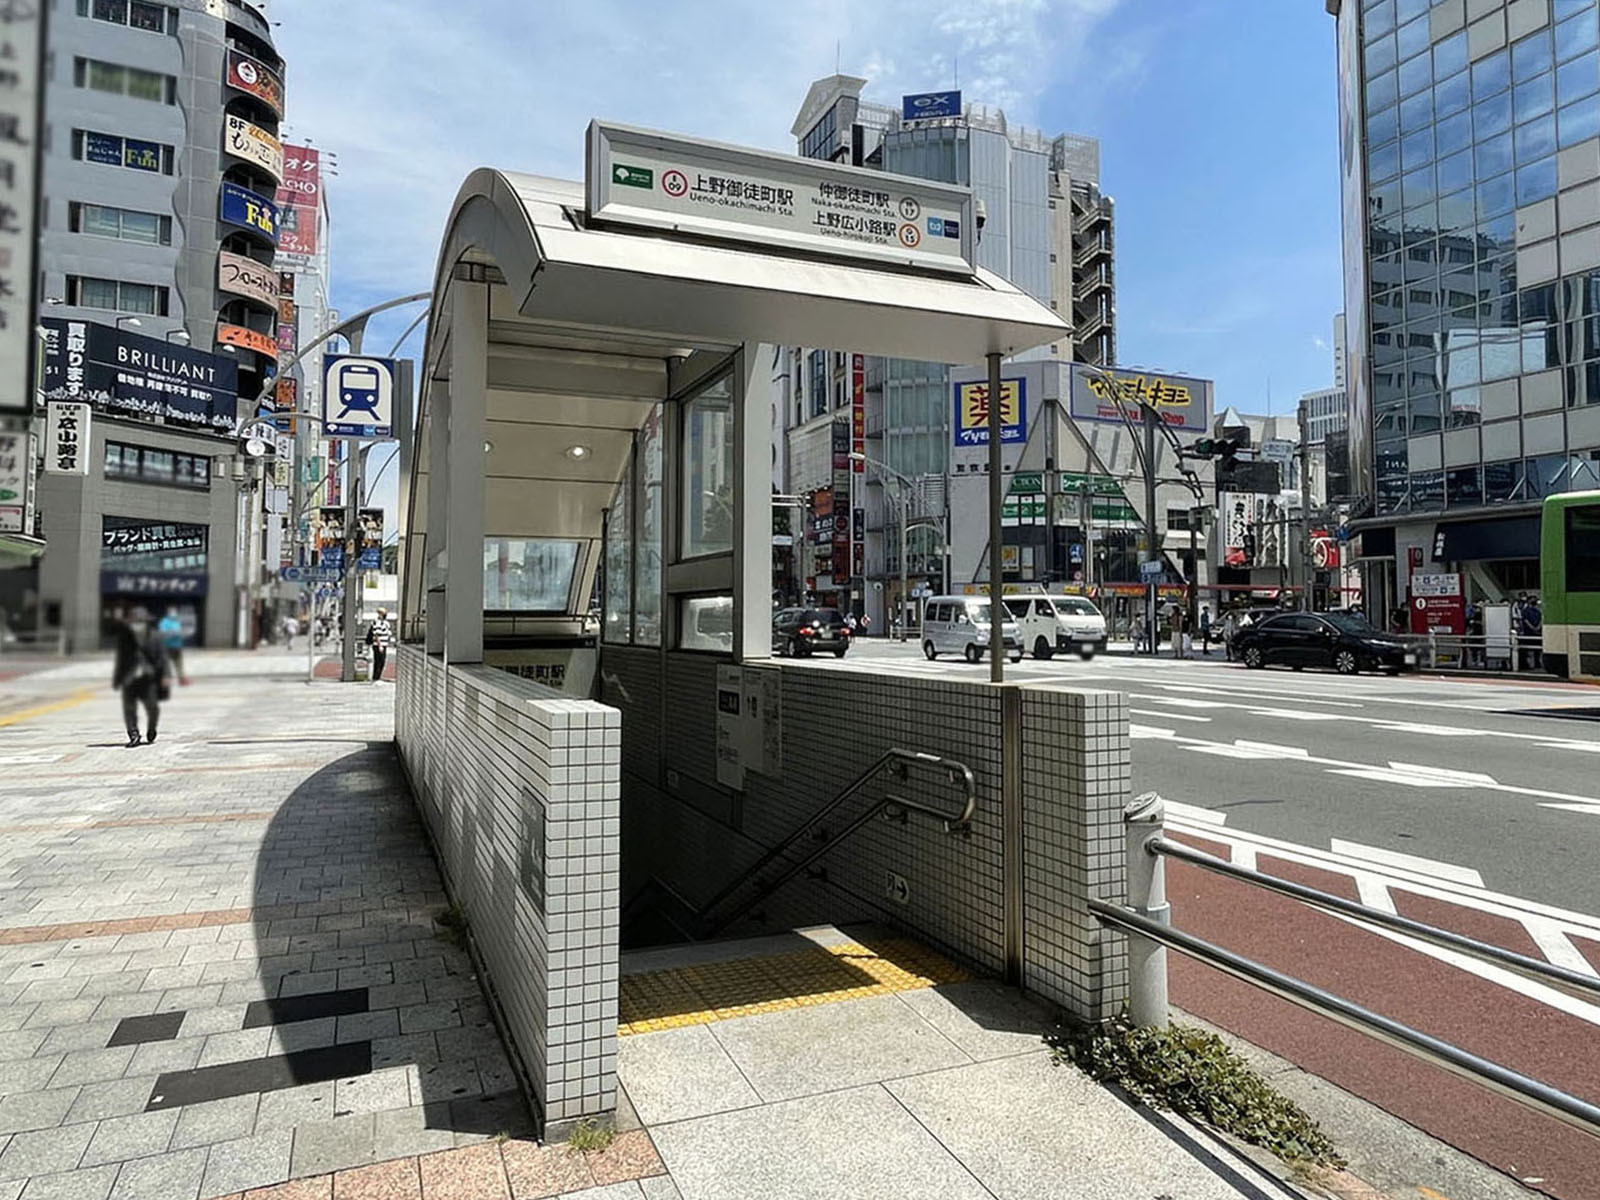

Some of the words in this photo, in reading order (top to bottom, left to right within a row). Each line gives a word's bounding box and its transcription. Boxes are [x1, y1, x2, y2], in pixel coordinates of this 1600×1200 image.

[668, 182, 682, 191] 09
[691, 174, 794, 207] 上野御徒町駅
[819, 181, 890, 208] 仲御徒町駅
[246, 201, 274, 235] Fun
[689, 192, 776, 214] Ueno-okachimachi
[778, 207, 796, 217] Sta.
[905, 208, 914, 216] 17
[812, 210, 896, 237] 上野広小路駅
[66, 322, 86, 396] 買取ります
[117, 345, 215, 383] BRILLIANT
[968, 384, 1010, 428] 薬
